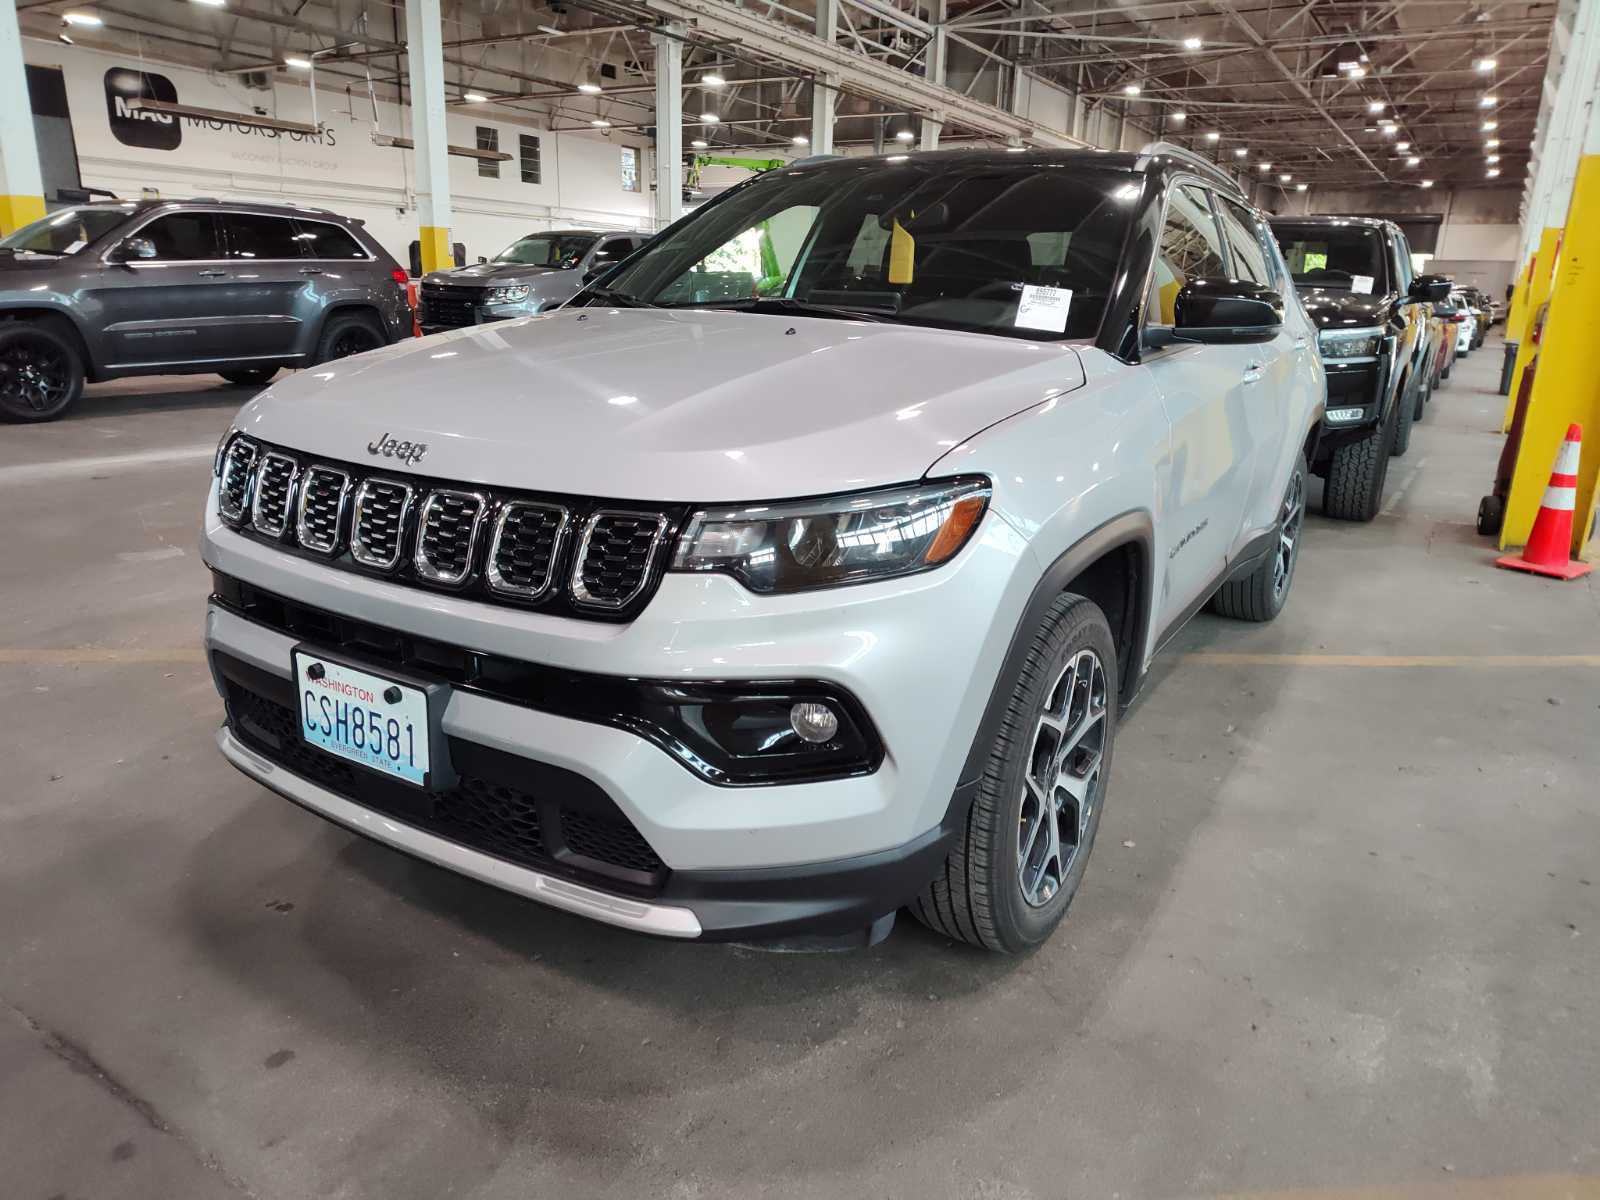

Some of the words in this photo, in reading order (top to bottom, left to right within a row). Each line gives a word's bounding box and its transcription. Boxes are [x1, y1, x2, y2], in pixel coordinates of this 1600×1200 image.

[367, 432, 427, 467] Jeep
[304, 690, 414, 767] CSH8581
[331, 741, 368, 760] EVERGREEN
[371, 755, 393, 769] STATE
